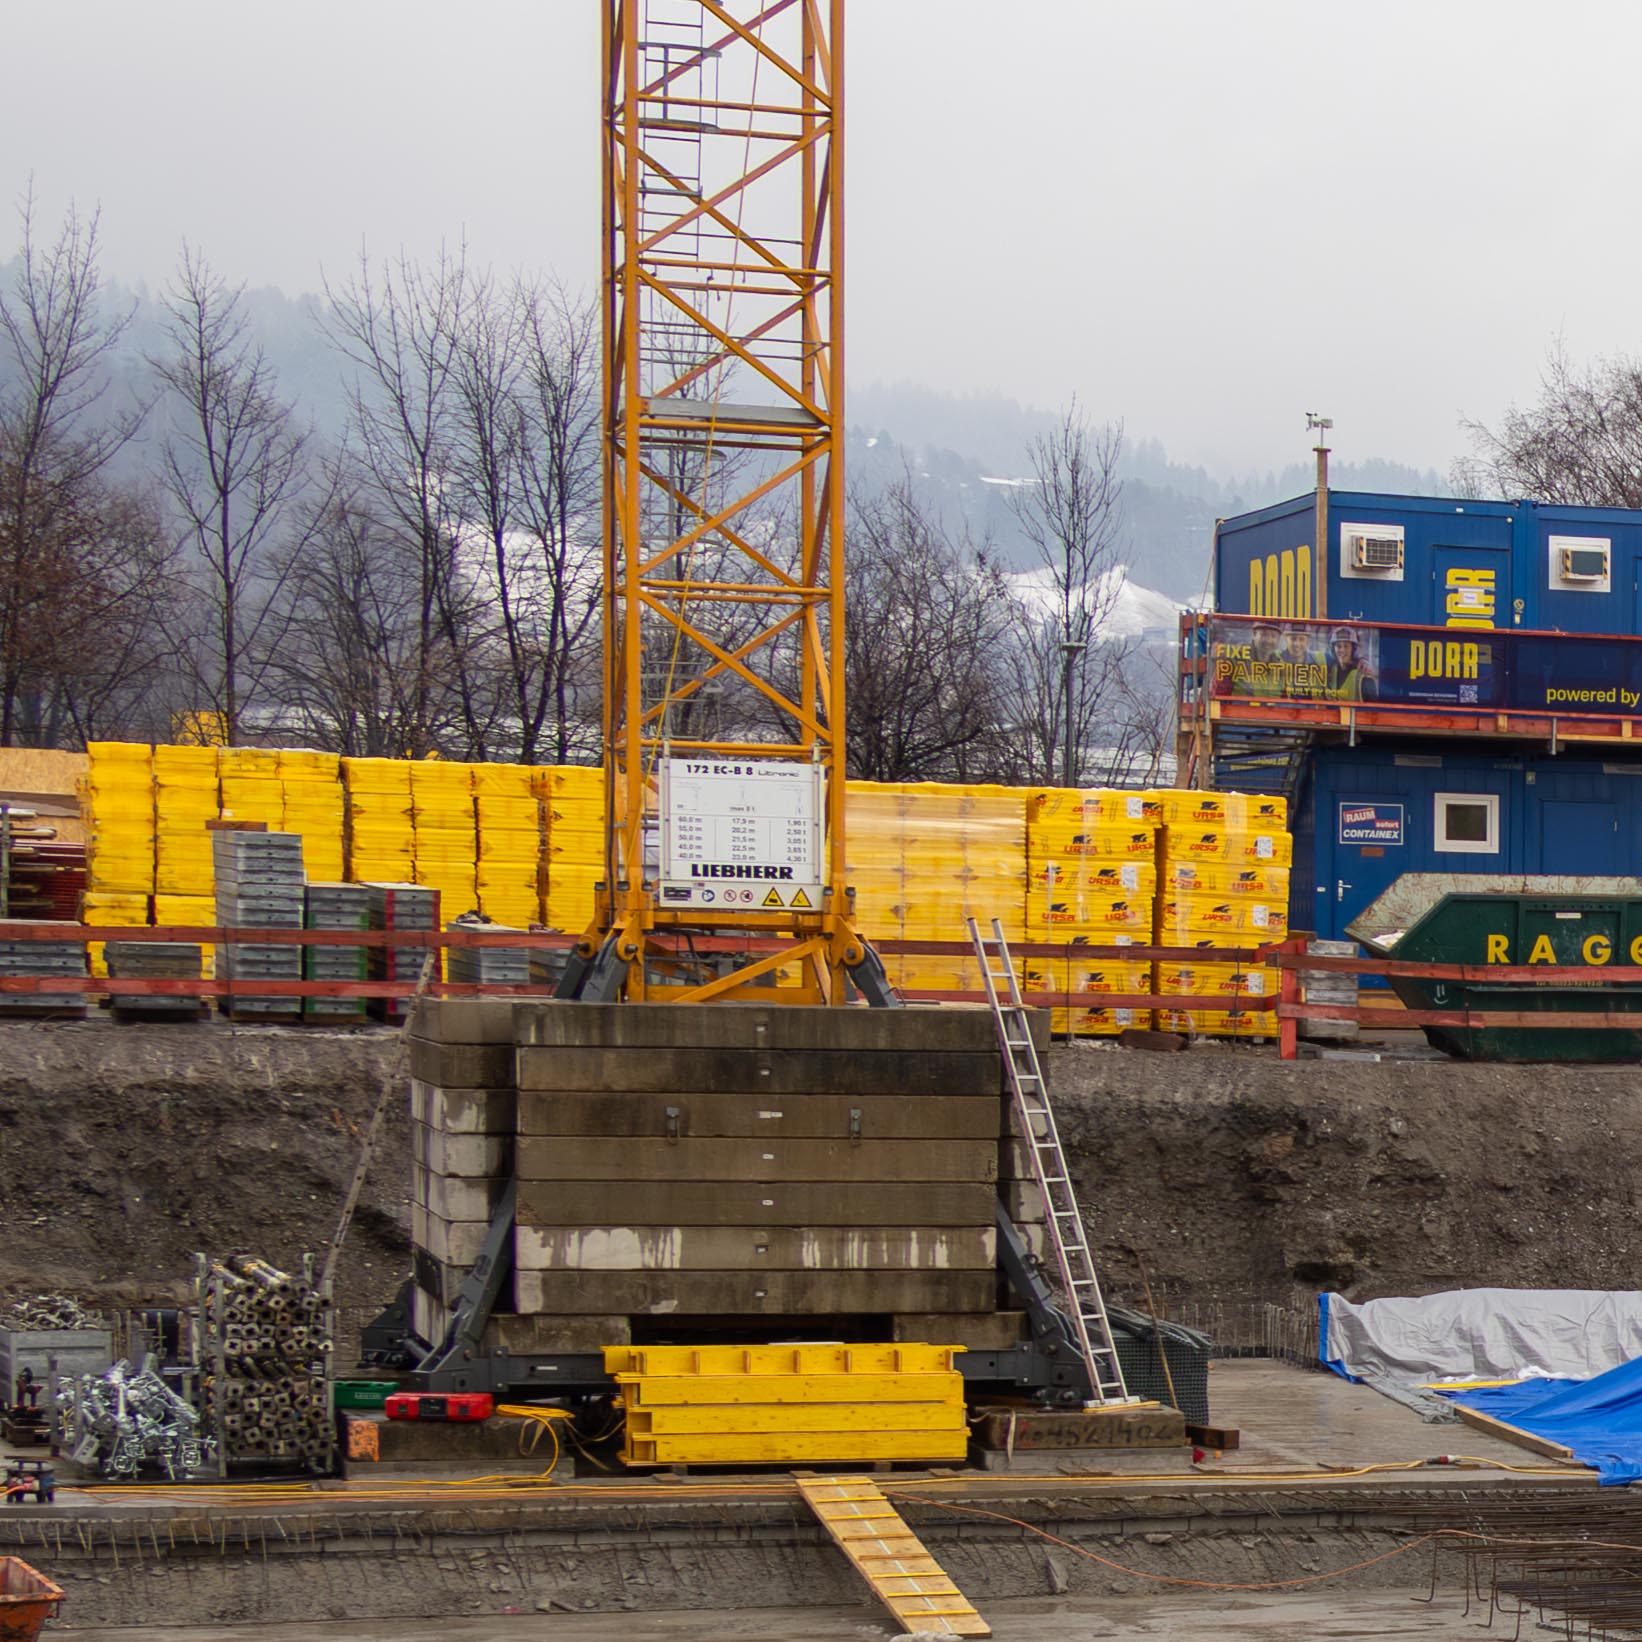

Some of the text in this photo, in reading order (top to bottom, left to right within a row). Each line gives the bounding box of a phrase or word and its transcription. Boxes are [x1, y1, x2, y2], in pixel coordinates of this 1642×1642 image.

[1216, 644, 1251, 659] FIXE
[1410, 640, 1478, 679] PORR
[1216, 660, 1328, 687] PARTIEN
[1547, 687, 1616, 704] powered
[1621, 689, 1641, 708] by
[686, 764, 709, 774] 172
[714, 766, 741, 775] EC-B
[746, 767, 753, 776] 8
[1344, 809, 1376, 823] RAUM
[1343, 829, 1399, 840] CONTAINEX
[691, 863, 794, 880] LIEBHERR
